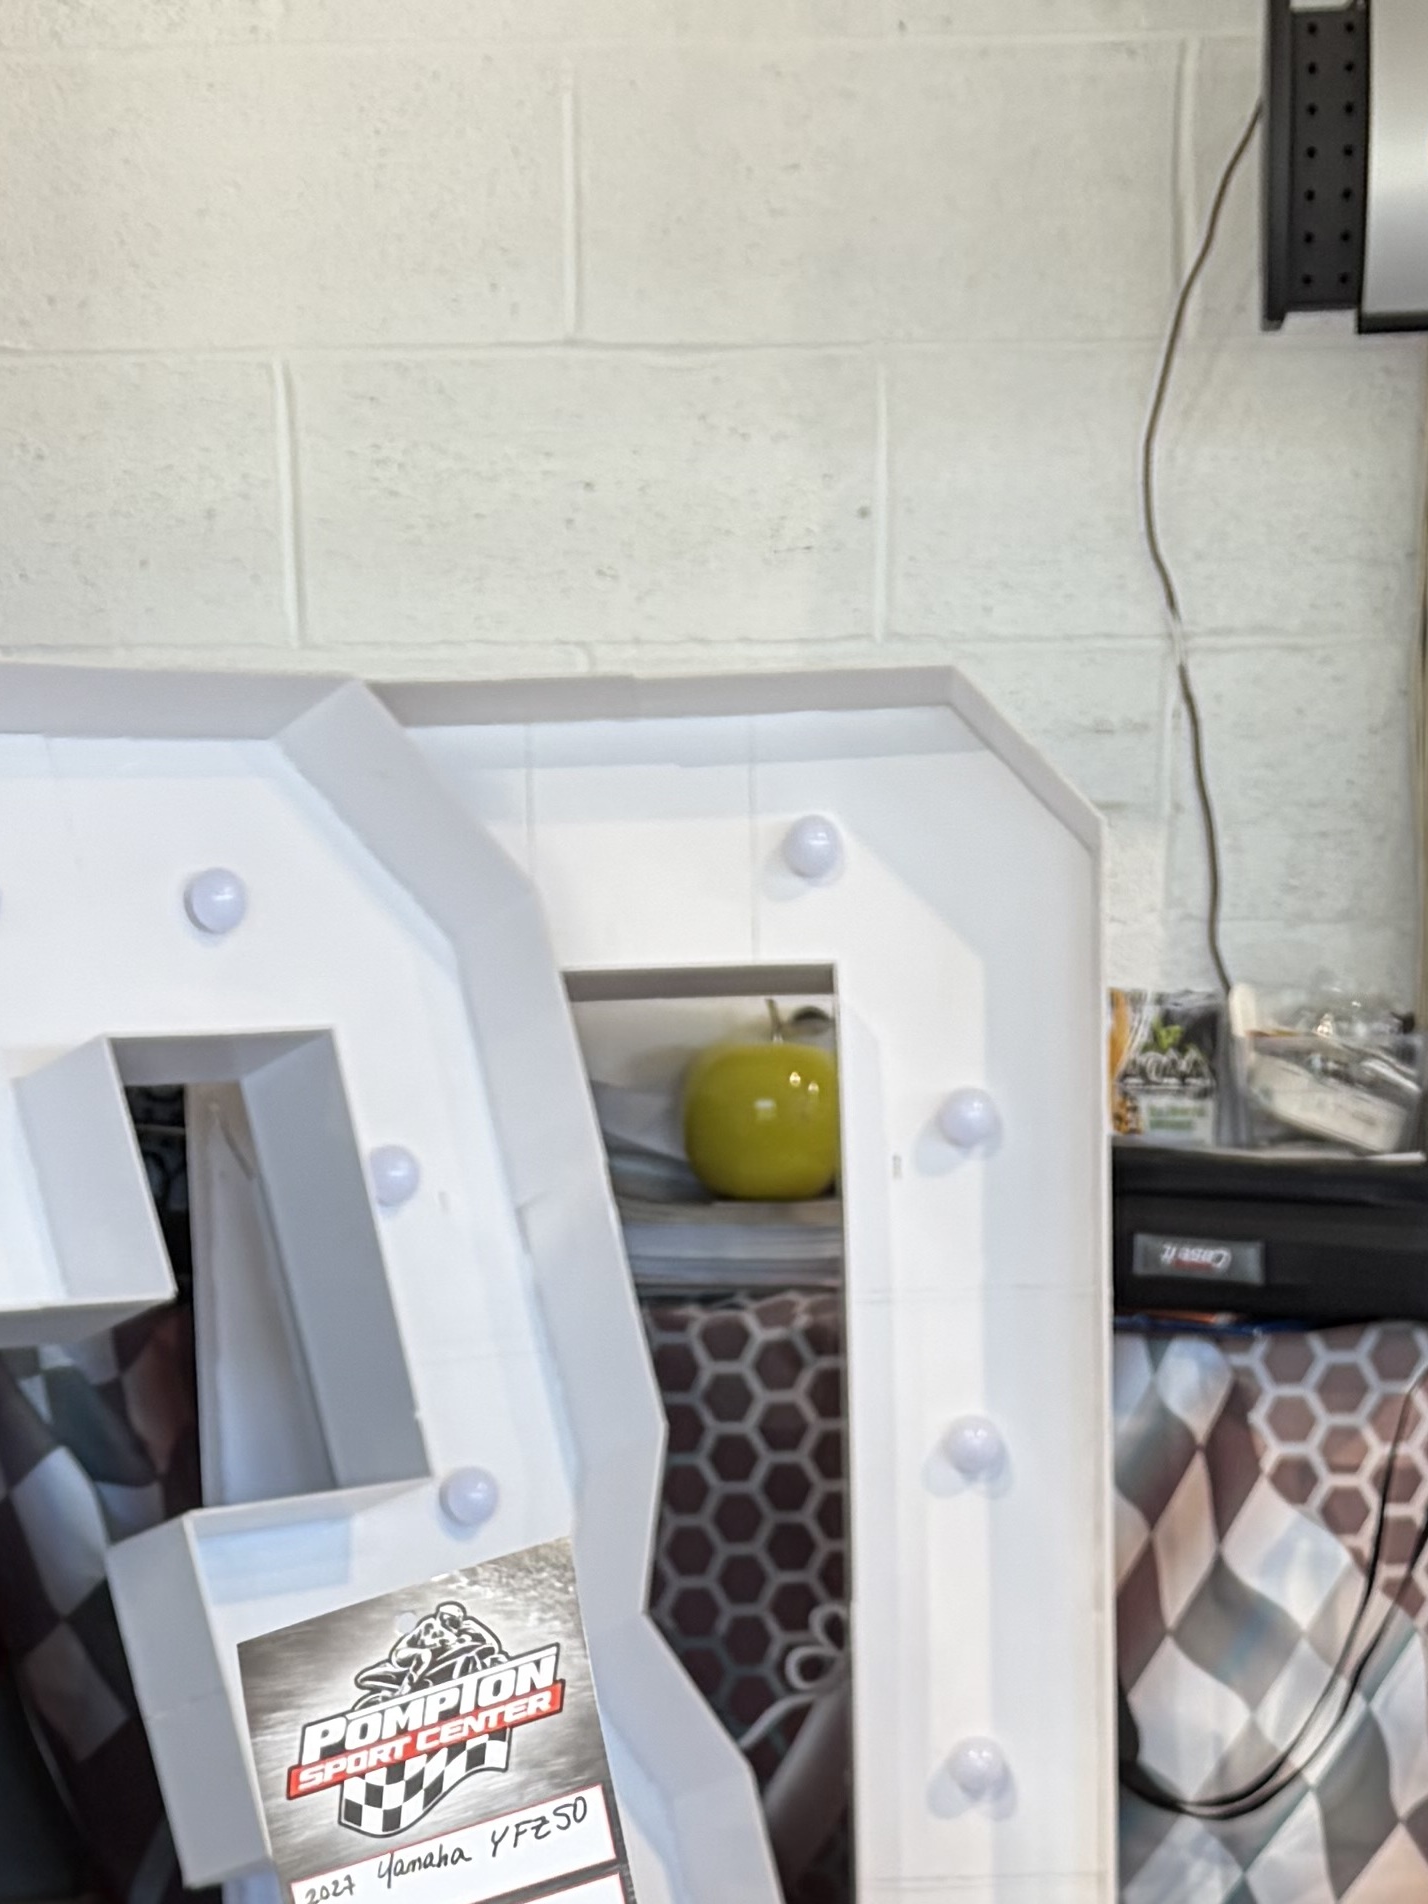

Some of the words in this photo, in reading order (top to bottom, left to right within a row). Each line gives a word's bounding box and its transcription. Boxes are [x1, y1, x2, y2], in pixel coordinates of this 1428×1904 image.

[297, 1737, 412, 1791] SPORT
[416, 1690, 552, 1752] CENTER
[299, 1653, 557, 1766] POMPTON
[377, 1843, 473, 1890] Yamaha
[490, 1796, 589, 1858] YFZ50
